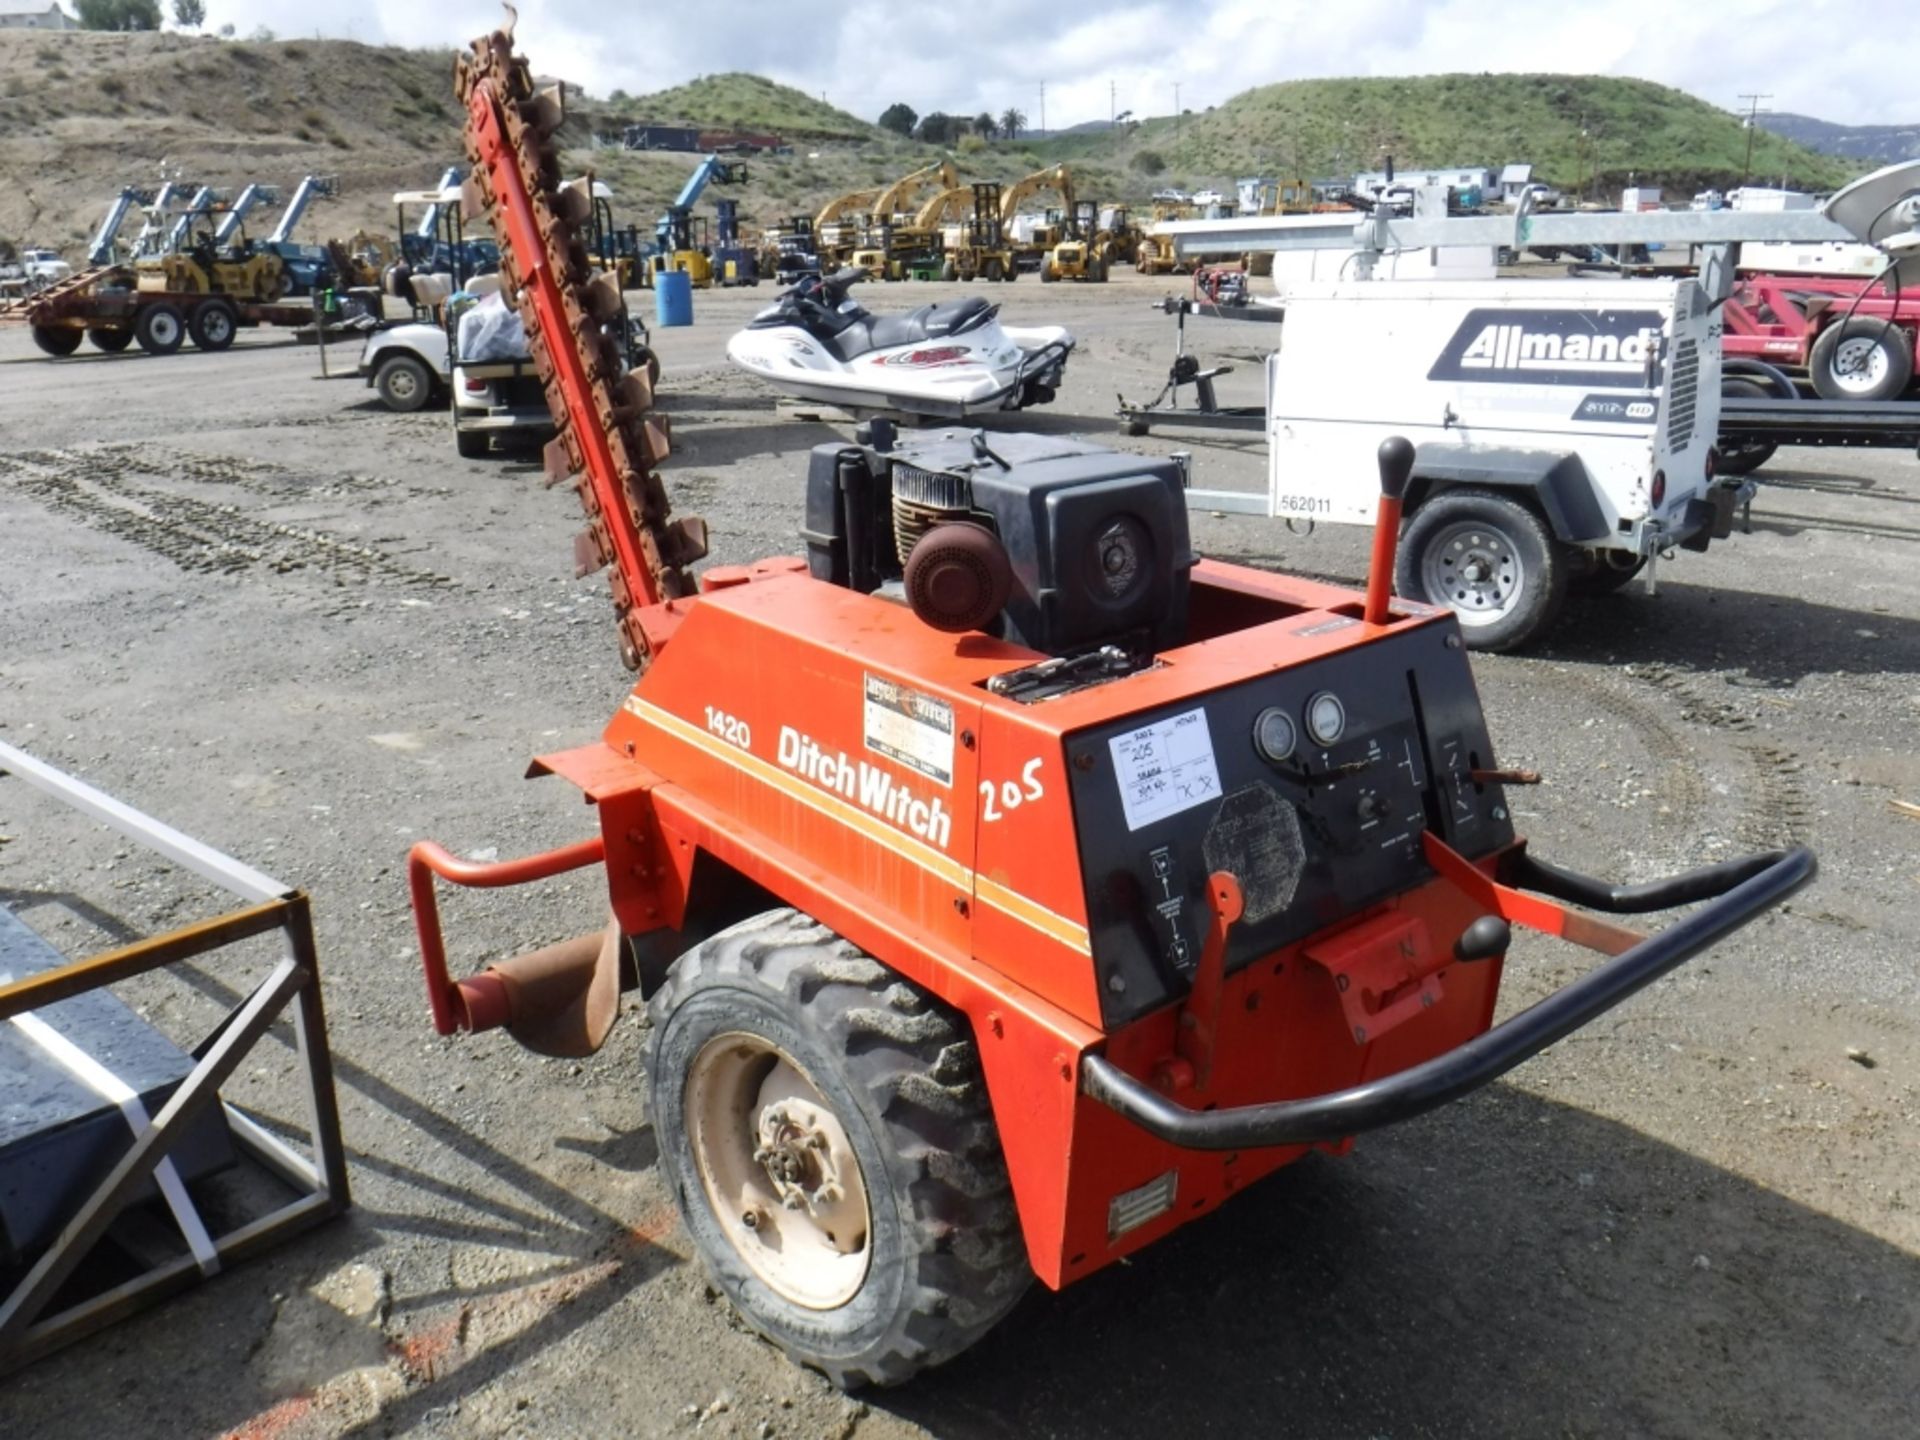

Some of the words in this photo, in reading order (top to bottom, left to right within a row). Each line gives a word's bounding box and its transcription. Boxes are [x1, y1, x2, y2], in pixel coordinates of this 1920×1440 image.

[1461, 325, 1658, 370] Allmand
[1281, 495, 1331, 512] 562011
[704, 705, 750, 750] 1420
[979, 757, 1044, 822] 205
